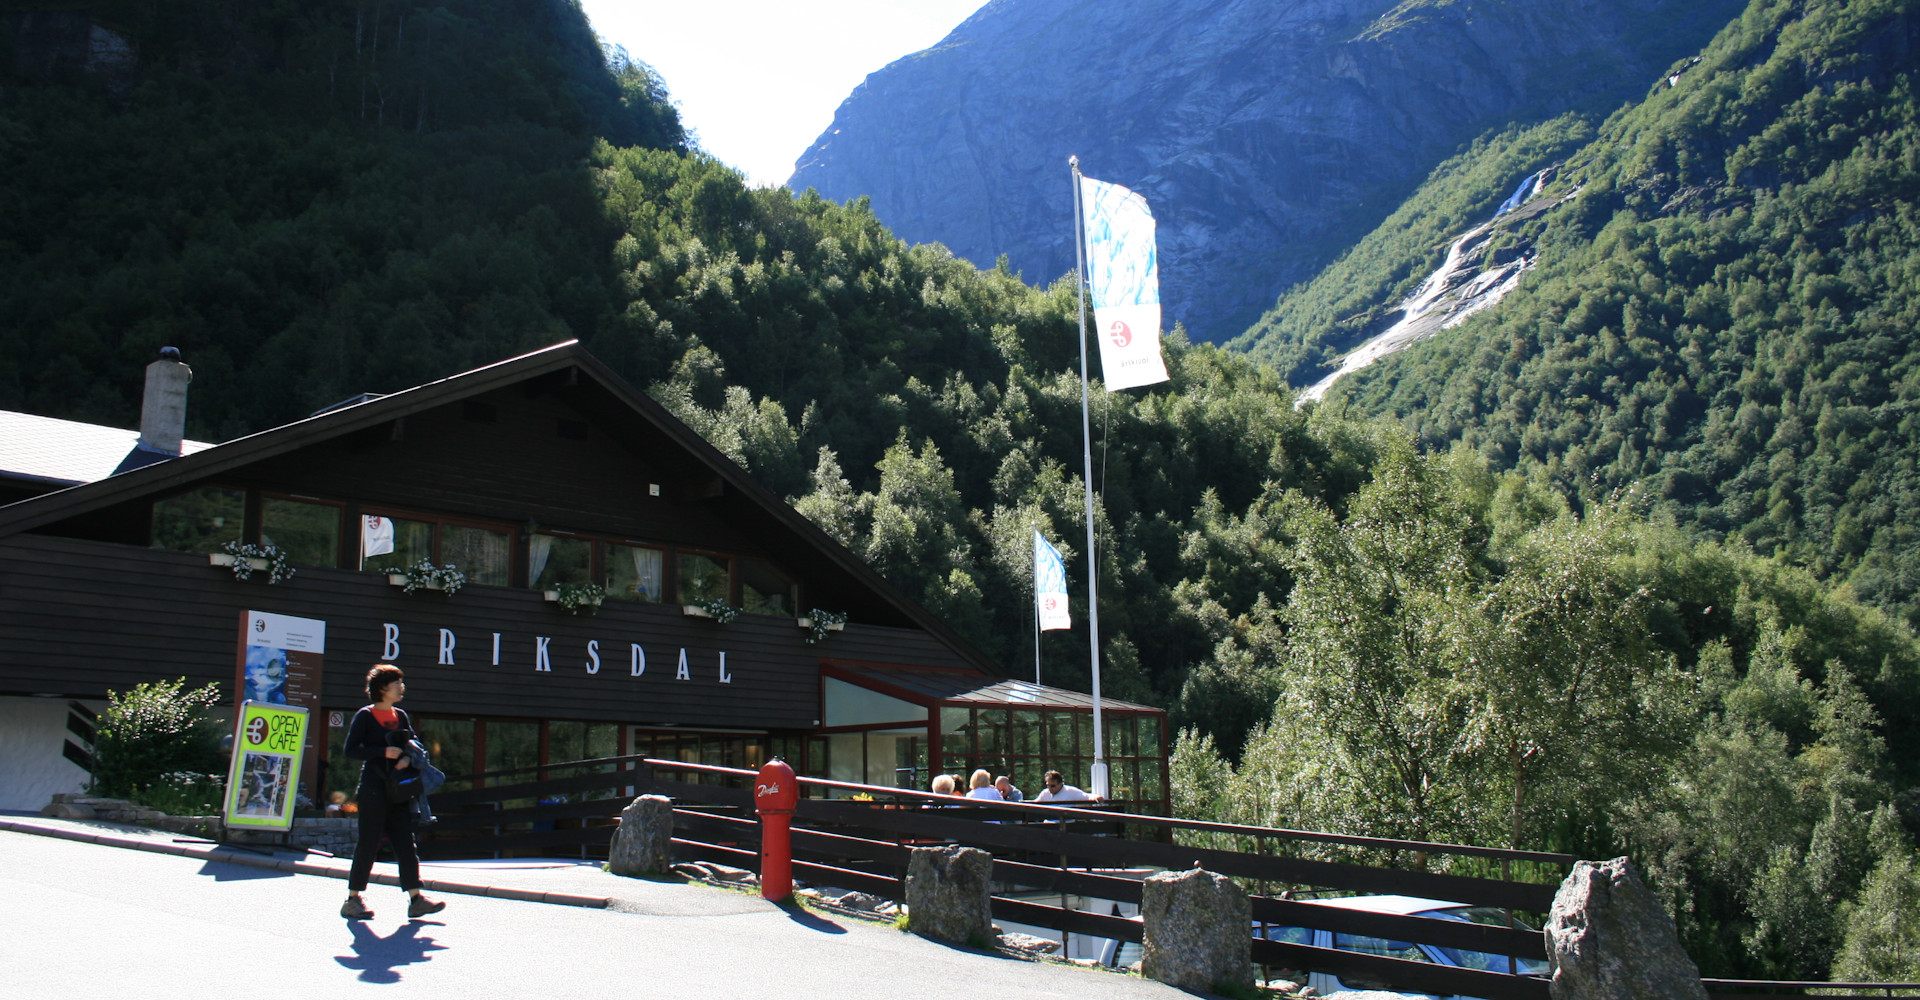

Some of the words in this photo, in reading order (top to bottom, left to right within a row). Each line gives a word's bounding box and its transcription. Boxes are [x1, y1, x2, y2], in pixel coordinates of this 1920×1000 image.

[381, 622, 732, 684] BRIKSDAL
[271, 714, 301, 734] OPEN
[269, 732, 298, 752] CAFE
